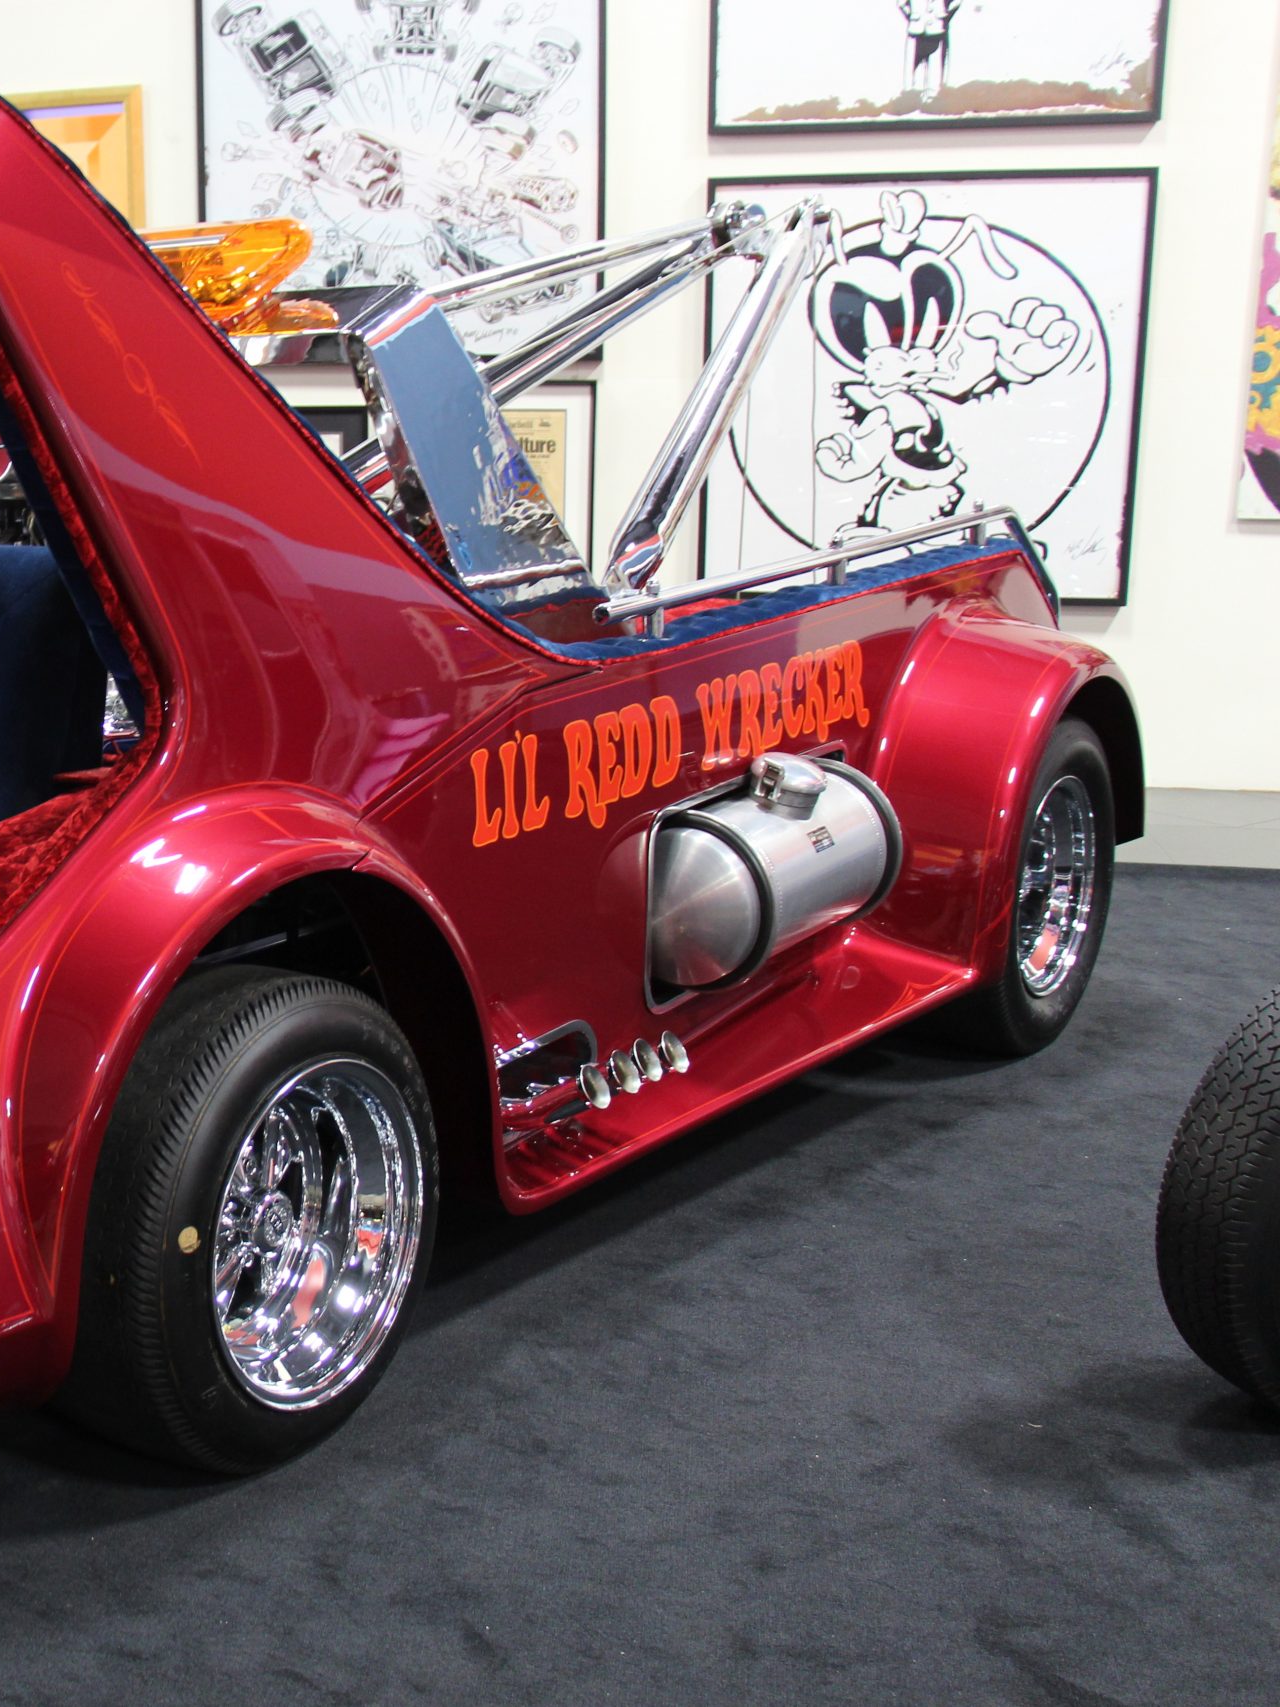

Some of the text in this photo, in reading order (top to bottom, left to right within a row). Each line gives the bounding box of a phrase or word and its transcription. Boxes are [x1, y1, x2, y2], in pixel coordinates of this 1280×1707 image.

[519, 437, 556, 453] lture
[470, 639, 870, 848] LI'L REDD WRECKER
